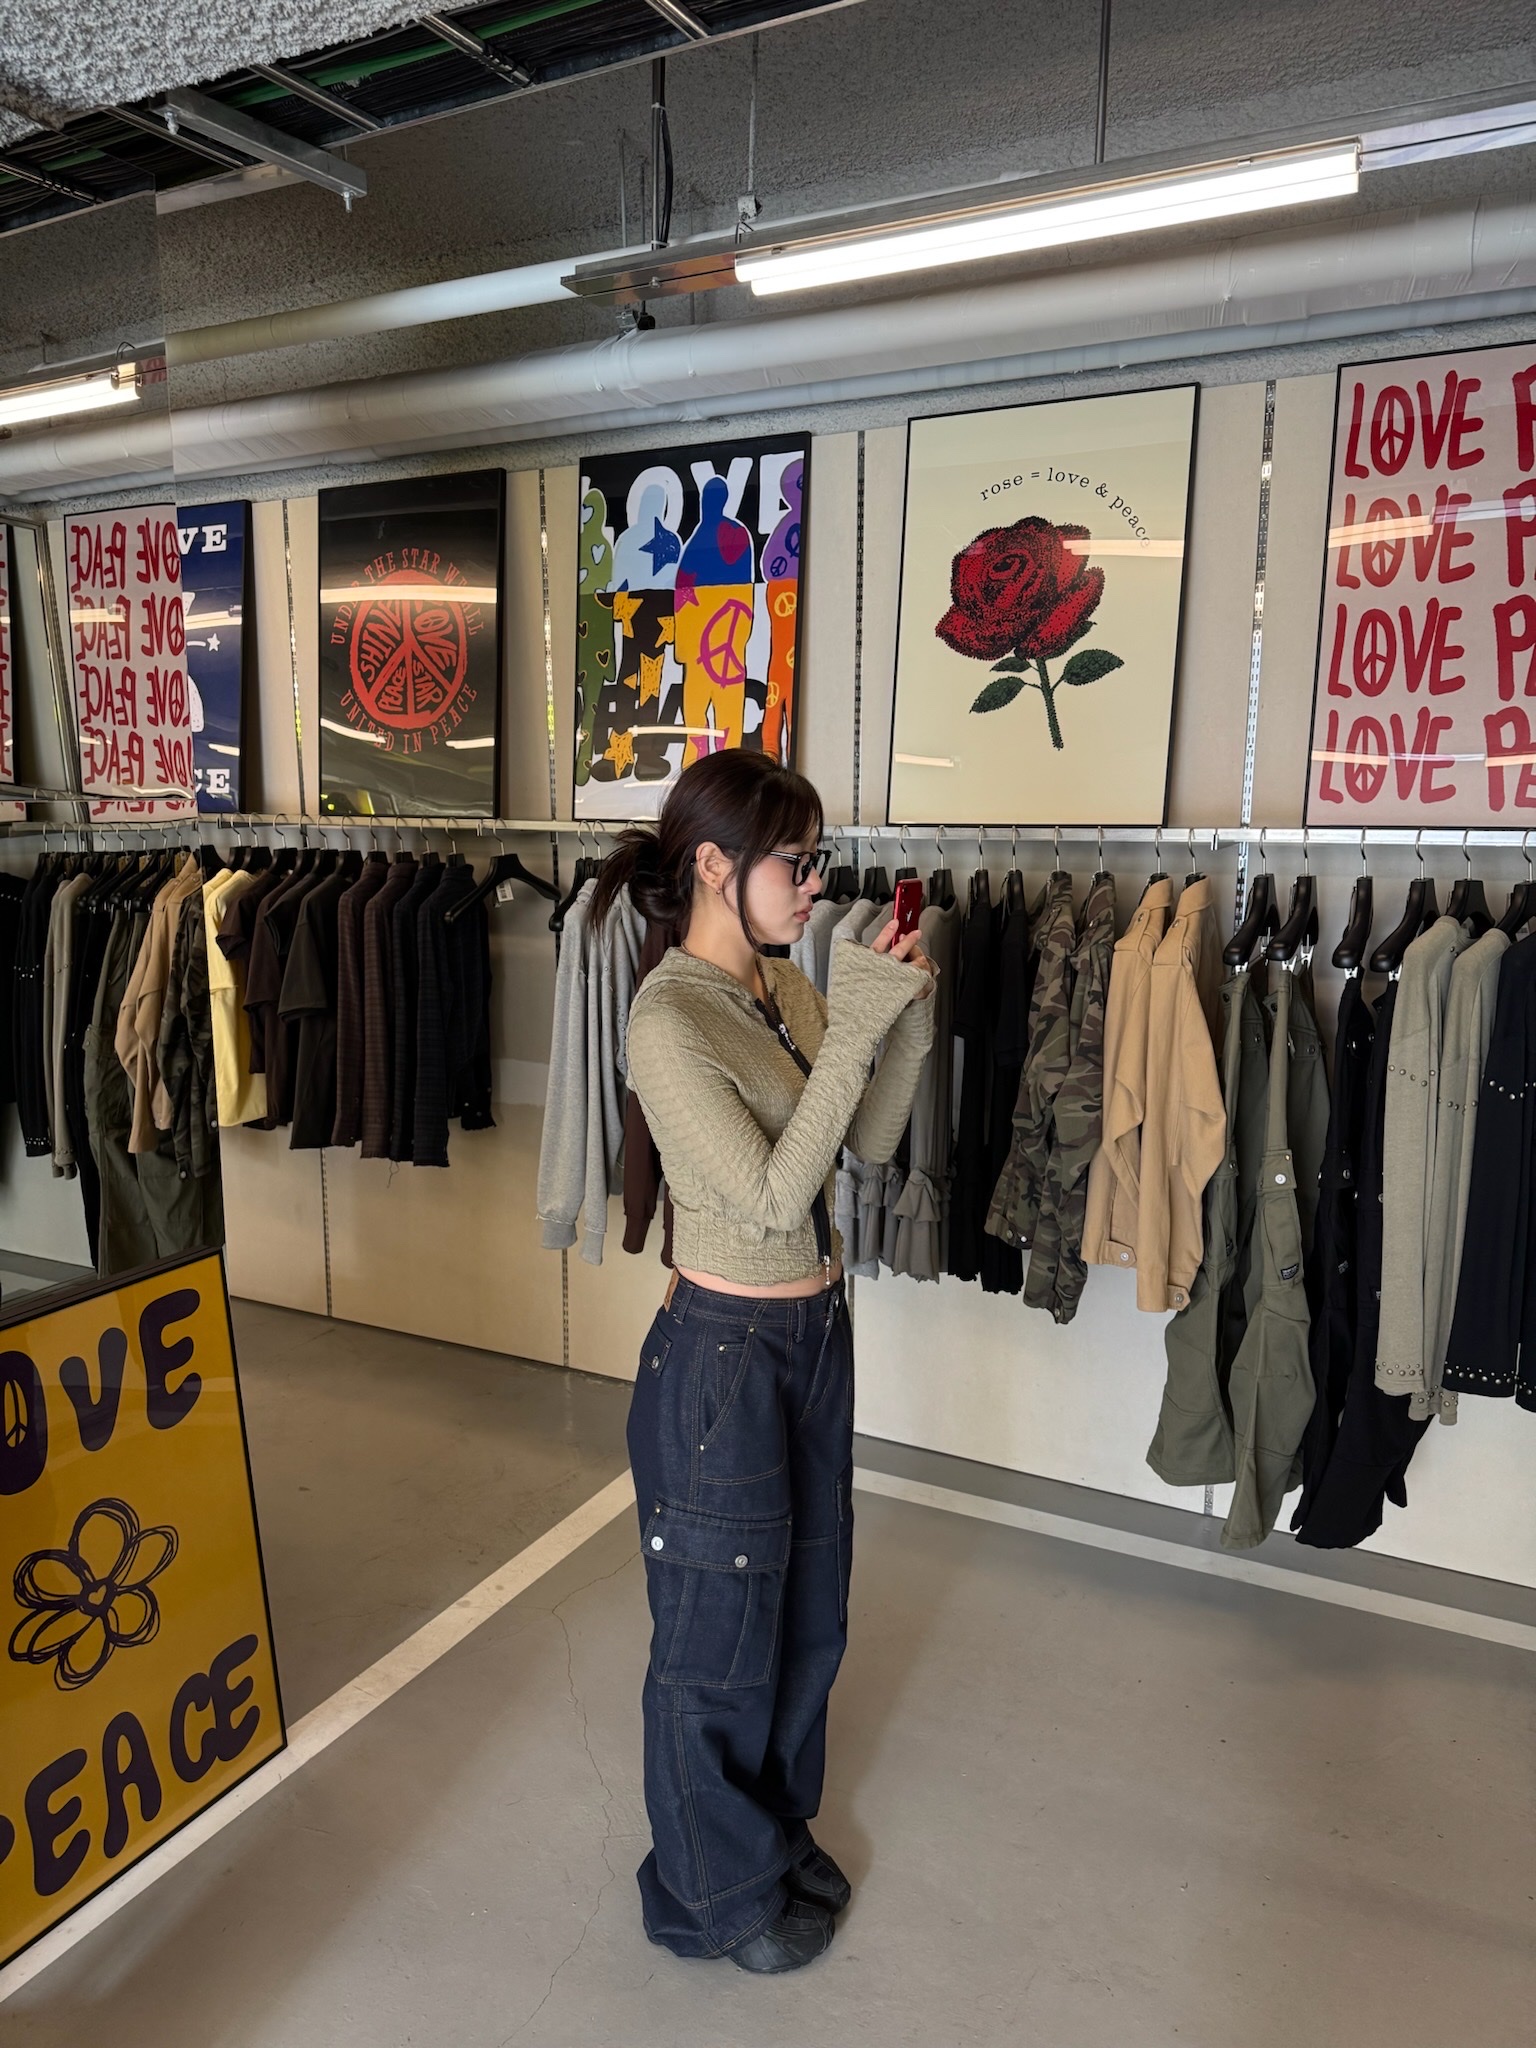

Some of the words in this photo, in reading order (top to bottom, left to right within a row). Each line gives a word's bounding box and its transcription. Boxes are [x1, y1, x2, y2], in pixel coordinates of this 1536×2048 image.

[1344, 369, 1485, 478] LOVE
[980, 475, 1024, 501] rose
[1047, 467, 1090, 488] love
[1095, 482, 1109, 498] &
[1108, 495, 1151, 549] peace
[1336, 484, 1475, 589] LOVE
[364, 552, 396, 584] THE
[401, 548, 441, 575] STAR
[413, 660, 443, 710] STAR
[1327, 597, 1466, 698] LOVE
[402, 731, 422, 755] IN
[429, 683, 478, 745] PEACE
[1319, 706, 1457, 804] LOVE
[0, 1288, 201, 1496] OVE
[0, 1634, 259, 1897] EACE
